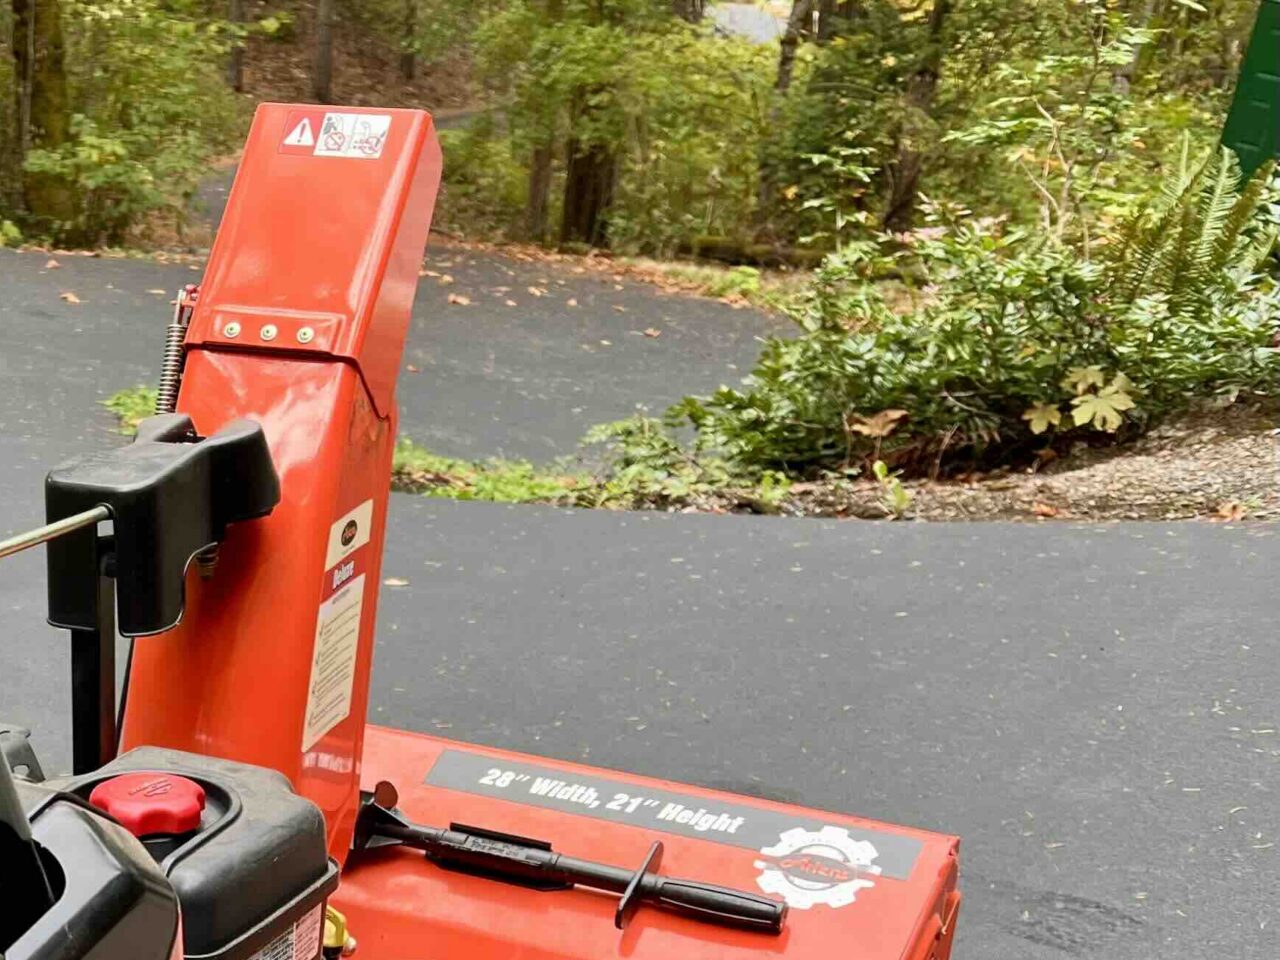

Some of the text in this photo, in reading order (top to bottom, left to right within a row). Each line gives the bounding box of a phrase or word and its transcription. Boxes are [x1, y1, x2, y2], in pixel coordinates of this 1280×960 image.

[478, 767, 745, 834] 28" Width, 21" Height
